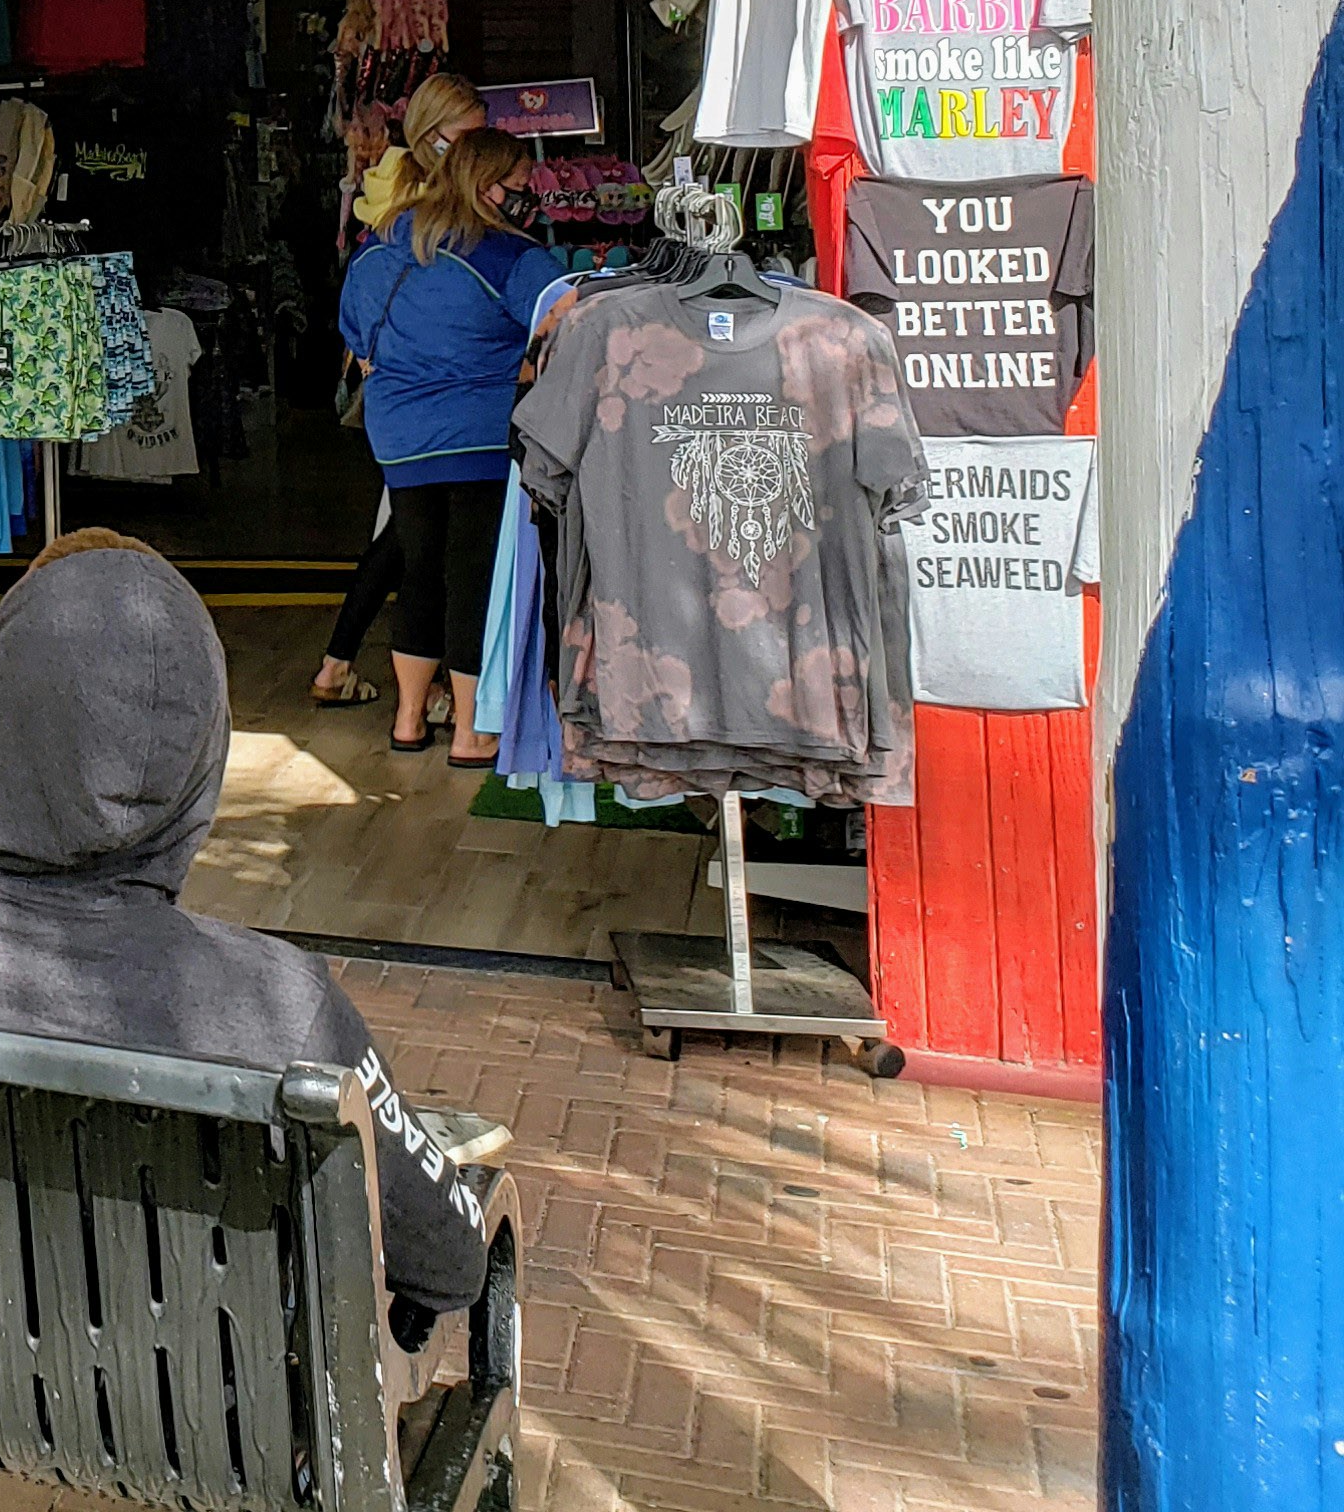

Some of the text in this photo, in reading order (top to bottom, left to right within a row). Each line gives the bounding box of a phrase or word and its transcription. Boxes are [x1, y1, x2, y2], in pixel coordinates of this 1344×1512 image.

[874, 35, 1063, 82] smoke like
[877, 86, 1061, 140] MARLEY
[921, 196, 1015, 234] YOU
[893, 246, 1050, 285] LOOKED
[897, 299, 1056, 337] BETTER
[905, 350, 1056, 389] ONLINE
[664, 404, 747, 426] MADEIRA
[926, 465, 1072, 502] ERMAIDS
[931, 511, 1042, 546] SMOKE
[916, 556, 1063, 592] SEAWEED
